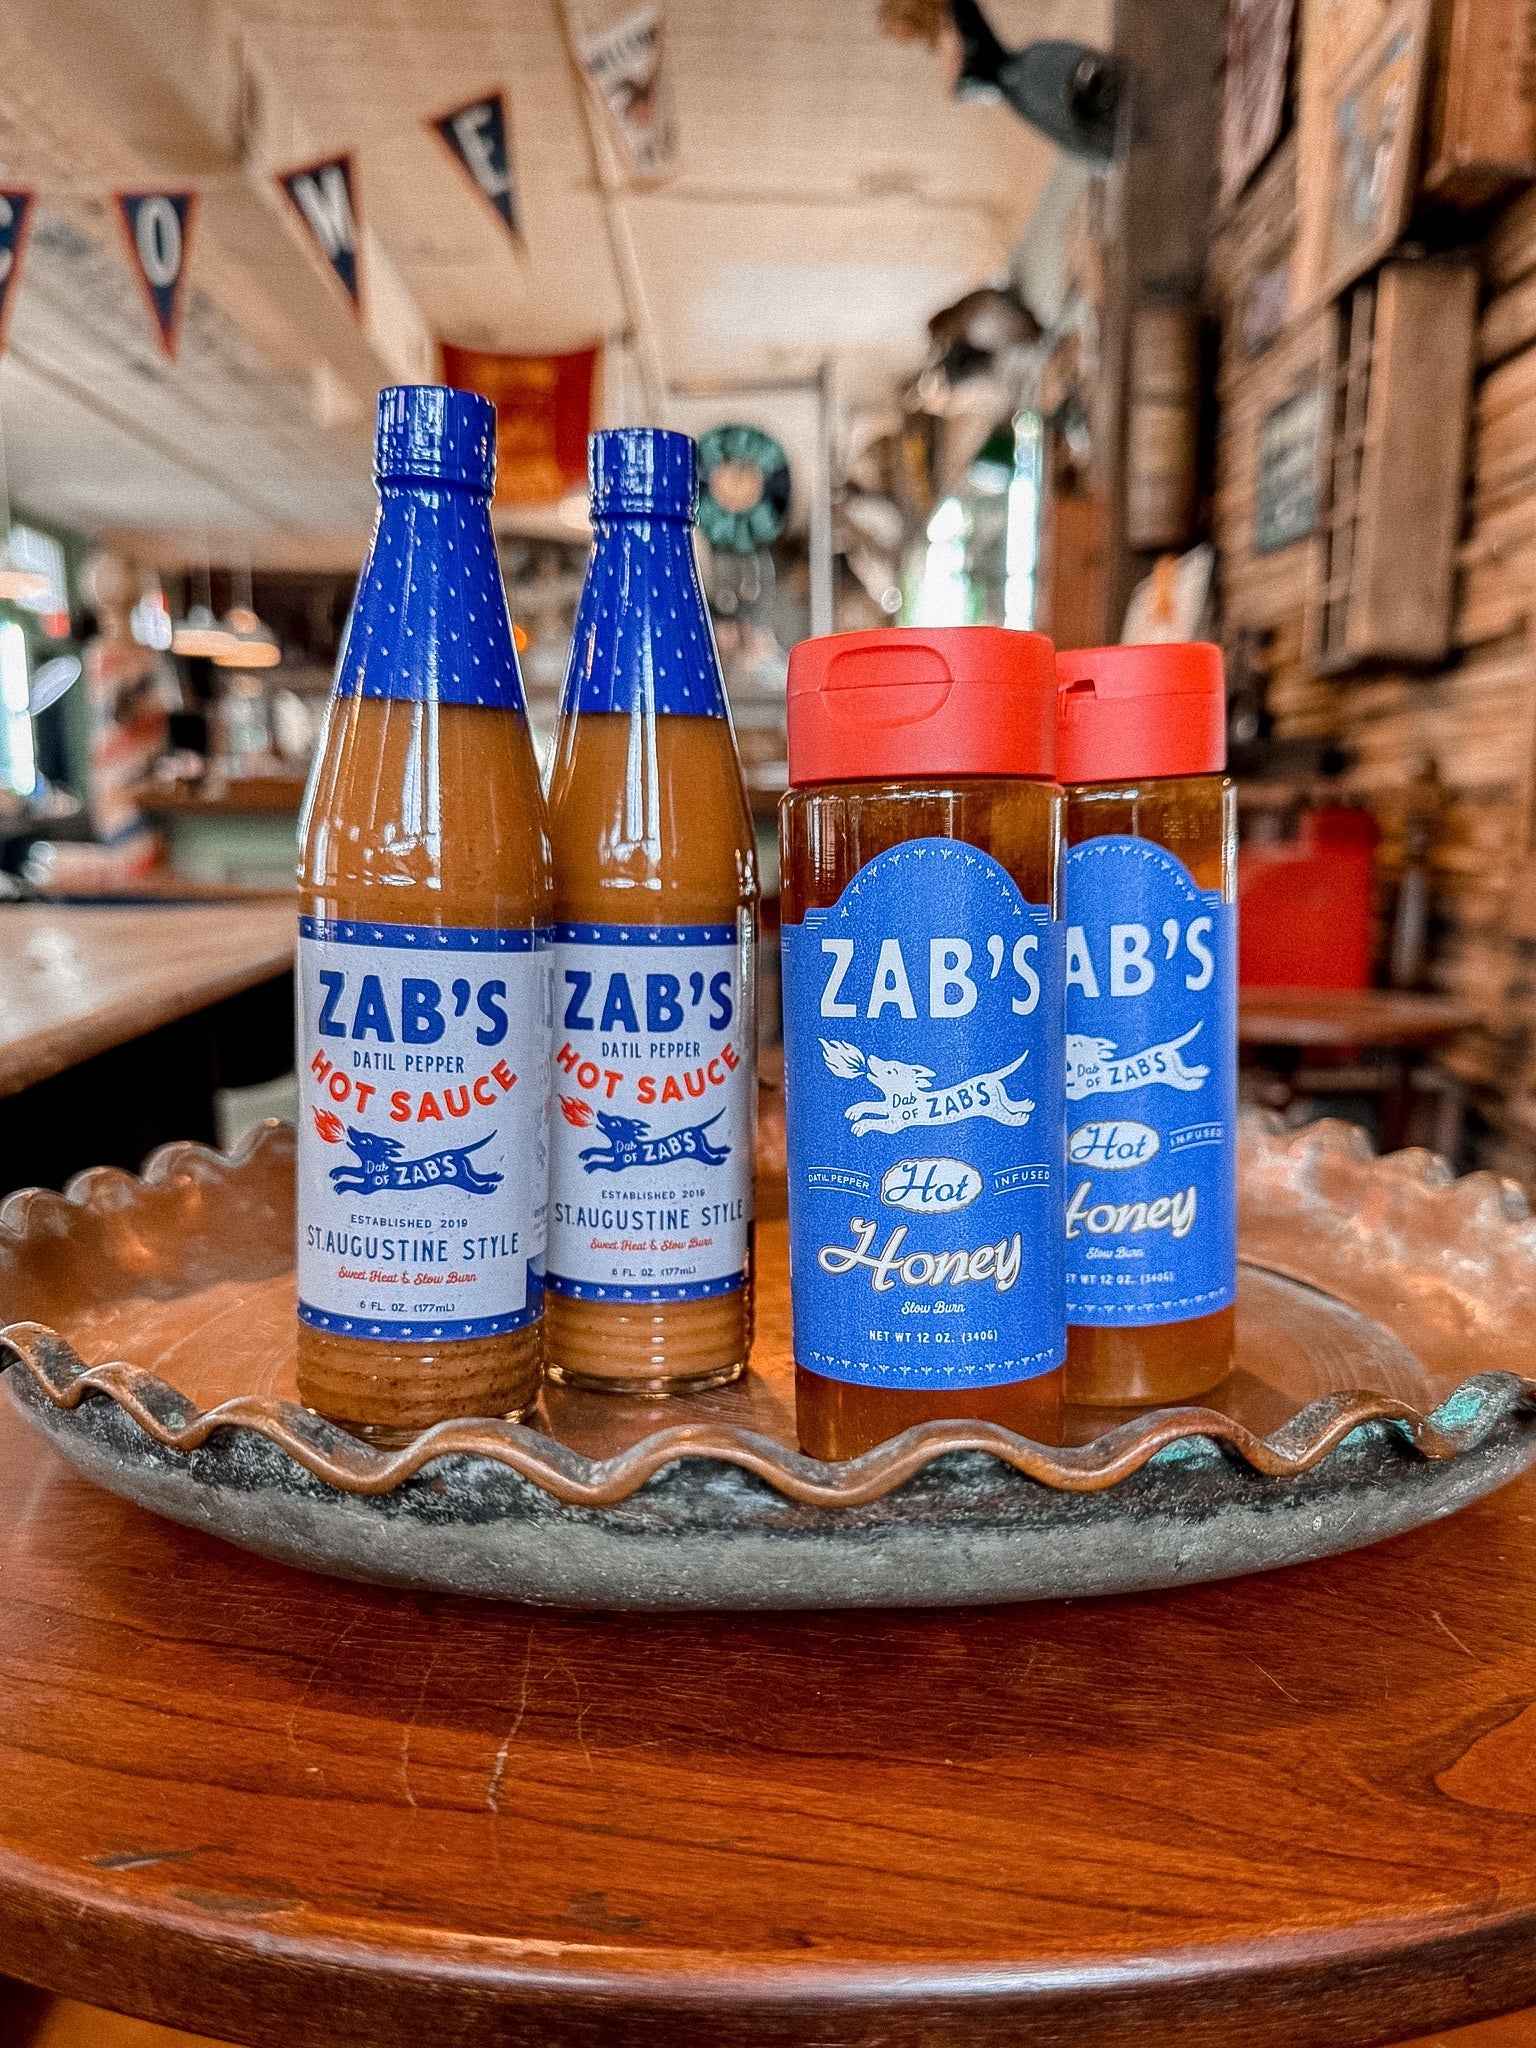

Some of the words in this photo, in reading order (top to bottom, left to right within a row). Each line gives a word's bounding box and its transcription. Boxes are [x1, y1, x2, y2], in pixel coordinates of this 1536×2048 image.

[1066, 916, 1214, 998] AB'S
[821, 934, 1040, 1018] ZAB'S
[319, 970, 509, 1046] ZAB'S
[564, 970, 734, 1033] ZAB'S
[353, 1051, 396, 1071] DATIL
[405, 1054, 464, 1074] PEPPER
[602, 1041, 642, 1059] DATIL
[650, 1041, 700, 1059] PEPPER
[556, 1041, 624, 1099] HOT
[636, 1041, 741, 1105] SAUCE
[1086, 1079, 1100, 1089] OF
[1108, 1052, 1167, 1086] ZAB'S
[311, 1048, 377, 1114] HOT
[388, 1058, 519, 1123] SAUCE
[892, 1092, 918, 1109] Dab
[902, 1109, 919, 1121] OF
[926, 1081, 991, 1120] ZAB'S
[623, 1151, 638, 1164] OF
[643, 1131, 697, 1162] ZAB'S
[1071, 1126, 1147, 1160] Hot
[366, 1159, 389, 1174] Dab
[375, 1174, 390, 1186] OF
[395, 1155, 458, 1186] ZAB'S
[808, 1173, 830, 1184] DATIL
[831, 1175, 871, 1190] PEPPER
[885, 1163, 969, 1203] Hot
[994, 1170, 1051, 1189] INFUSED
[602, 1189, 677, 1201] ESTABLISHED
[682, 1188, 706, 1199] 2019
[350, 1213, 433, 1229] ESTABLISHED
[440, 1218, 468, 1229] 2019
[701, 1199, 744, 1227] STYLE
[462, 1232, 519, 1262] STYLE
[620, 1238, 647, 1251] Heat
[660, 1239, 687, 1252] Slow
[818, 1216, 1023, 1293] Honey
[337, 1266, 367, 1280] Sweet
[368, 1270, 399, 1283] Heat
[402, 1270, 411, 1285] &
[413, 1271, 443, 1286] Slow
[446, 1271, 478, 1284] Burn
[622, 1268, 637, 1277] FL.
[1066, 1273, 1077, 1284] ET
[1100, 1274, 1113, 1286] 12
[360, 1301, 366, 1311] 6
[371, 1302, 386, 1312] FL.
[391, 1303, 408, 1313] OZ.
[414, 1303, 456, 1313] (177mL)
[901, 1301, 931, 1316] Slow
[933, 1301, 966, 1316] Burn
[869, 1330, 890, 1342] NET
[895, 1332, 912, 1343] WT
[917, 1332, 930, 1343] 12
[935, 1332, 955, 1344] OZ.
[961, 1329, 998, 1344] (340G)
